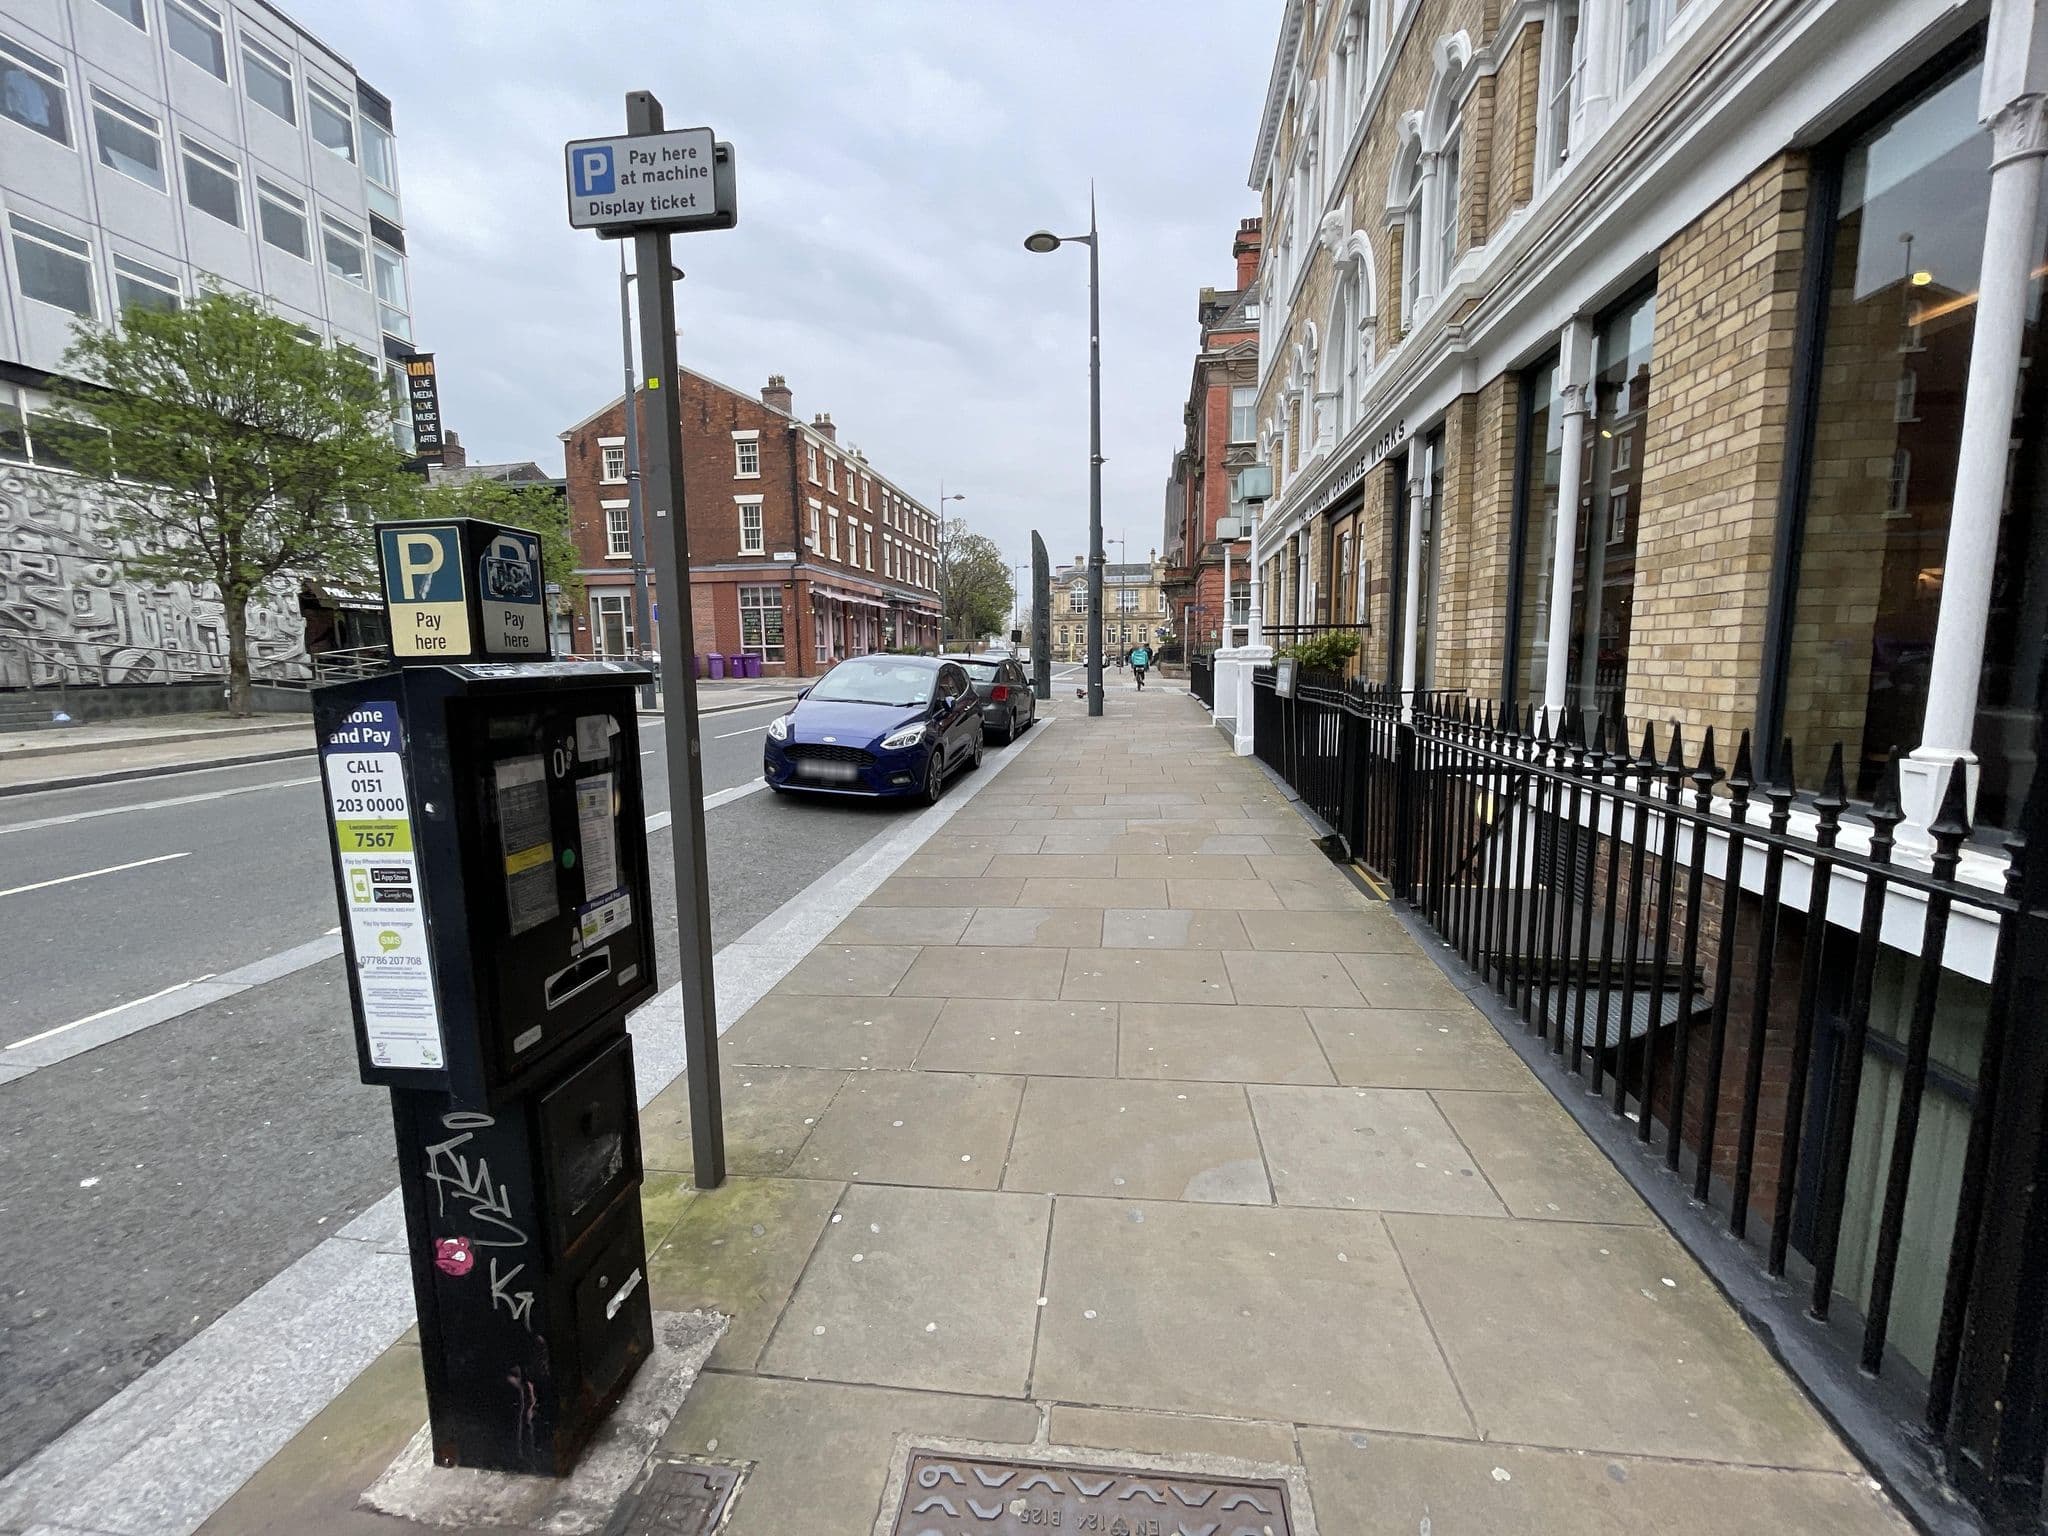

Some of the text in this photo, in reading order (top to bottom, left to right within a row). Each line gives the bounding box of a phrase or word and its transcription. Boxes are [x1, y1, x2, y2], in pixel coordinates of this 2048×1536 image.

[630, 147, 697, 166] Pay here
[583, 153, 608, 191] P
[621, 165, 708, 185] at machine
[590, 193, 696, 216] Display ticket
[414, 380, 431, 388] LOVE
[412, 390, 434, 399] MEDIA
[416, 402, 433, 410] LOVE
[415, 413, 437, 422] MUSIC
[419, 424, 435, 432] LOVE
[420, 435, 437, 443] ARTS
[1332, 456, 1366, 498] CARRIAGE
[1370, 419, 1405, 465] WORKS
[397, 533, 444, 600] P
[416, 612, 441, 630] Pay
[505, 611, 524, 630] Pay
[416, 634, 447, 650] here
[504, 633, 529, 648] here
[330, 728, 391, 746] and Pay
[347, 760, 384, 773] CALL
[351, 779, 383, 793] 0151
[337, 798, 404, 812] 203 0000
[355, 833, 395, 847] 7567
[382, 874, 393, 882] App
[380, 936, 400, 944] SMS
[361, 956, 422, 965] 07786 207 708
